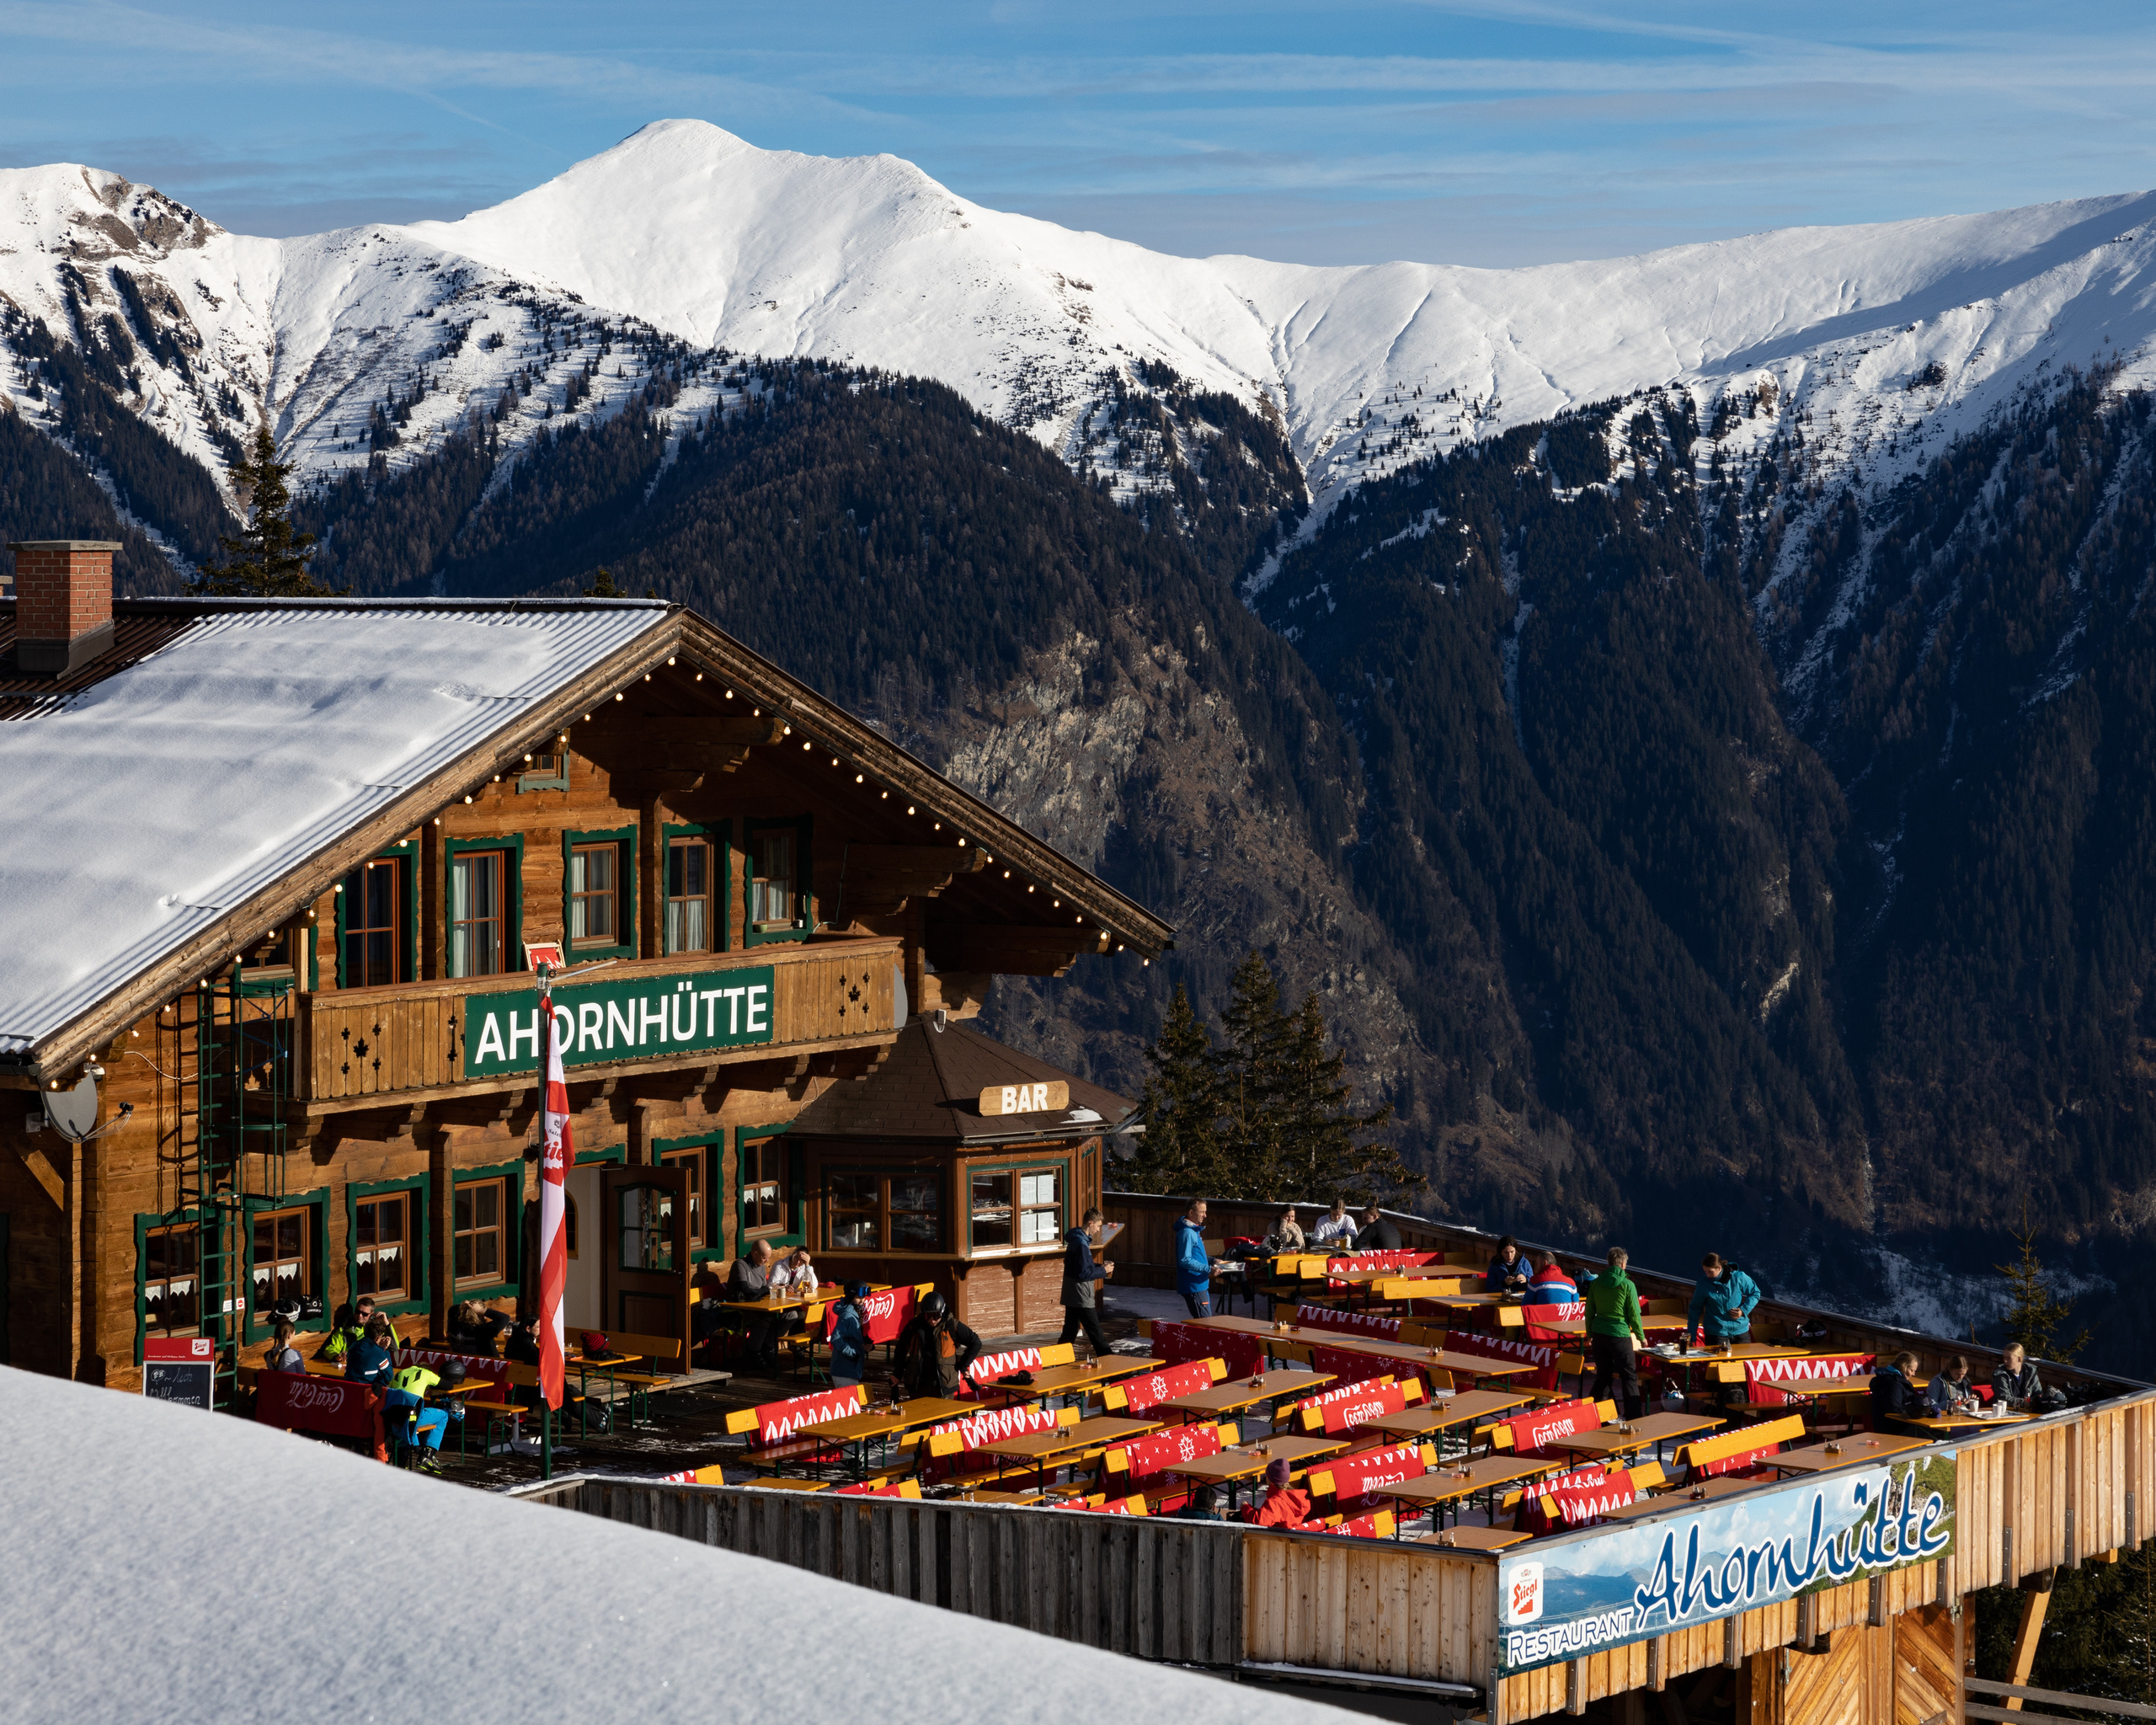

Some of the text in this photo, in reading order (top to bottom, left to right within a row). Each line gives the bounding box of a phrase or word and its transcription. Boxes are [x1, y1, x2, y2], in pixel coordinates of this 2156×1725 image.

[474, 981, 767, 1064] AHORNHÜTTE
[1001, 1083, 1049, 1114] BAR
[286, 1381, 344, 1413] Coca-Cola
[1509, 1471, 1949, 1665] RESTAURANT Ahornhütte
[1513, 1578, 1538, 1610] Stiegl
